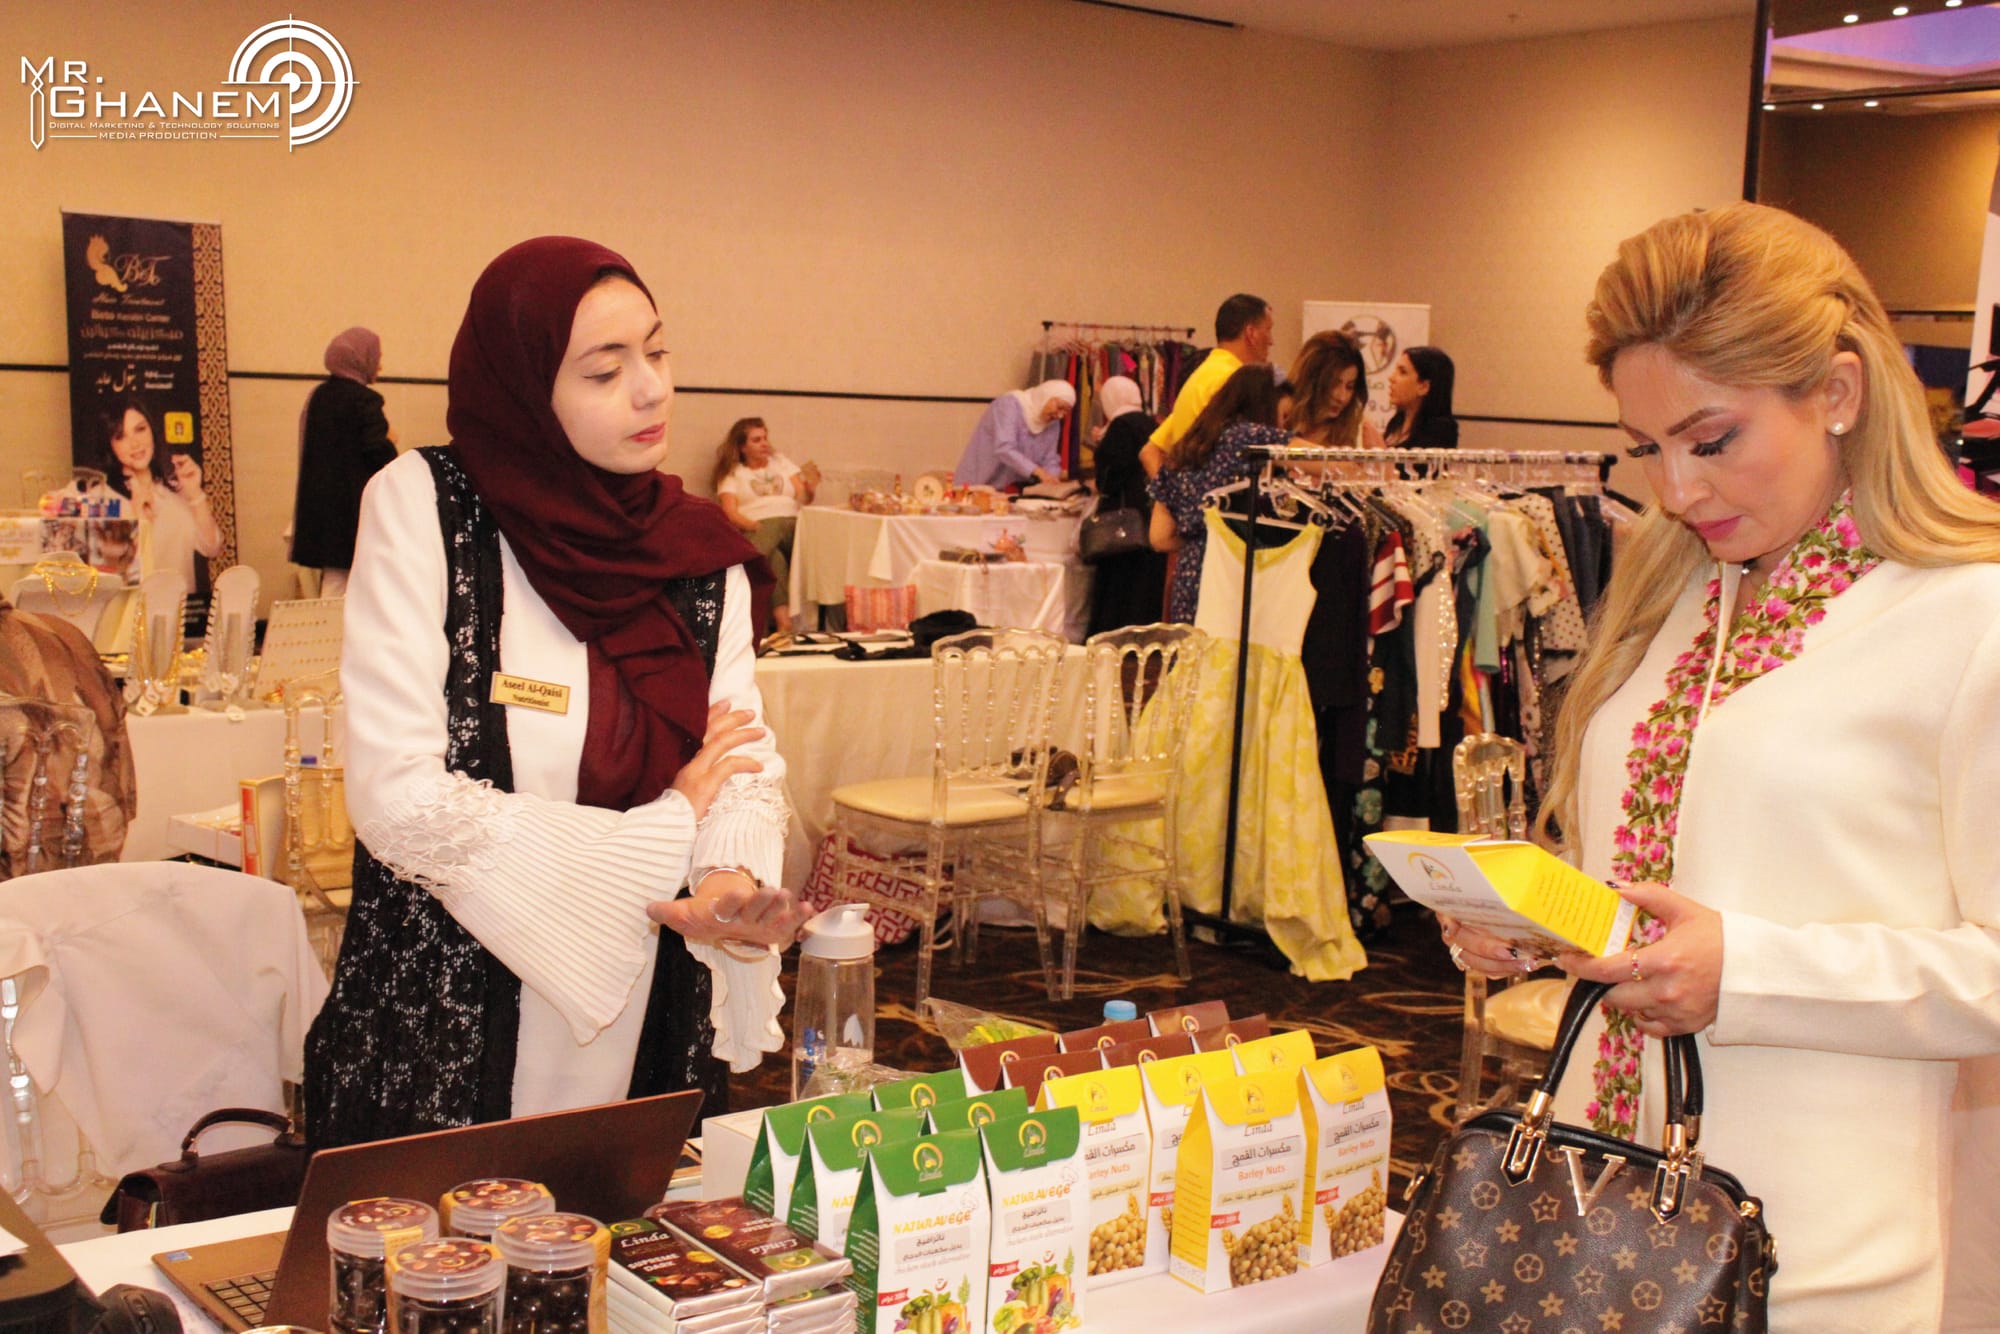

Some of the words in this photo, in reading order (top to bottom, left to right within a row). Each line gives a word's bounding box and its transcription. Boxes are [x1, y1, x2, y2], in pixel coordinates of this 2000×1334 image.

[1088, 1168, 1109, 1179] arley
[1111, 1163, 1130, 1173] Nuts
[1238, 1167, 1265, 1181] Barley
[1266, 1163, 1286, 1175] Nuts
[621, 1232, 671, 1248] Linda
[749, 1238, 798, 1255] Linda
